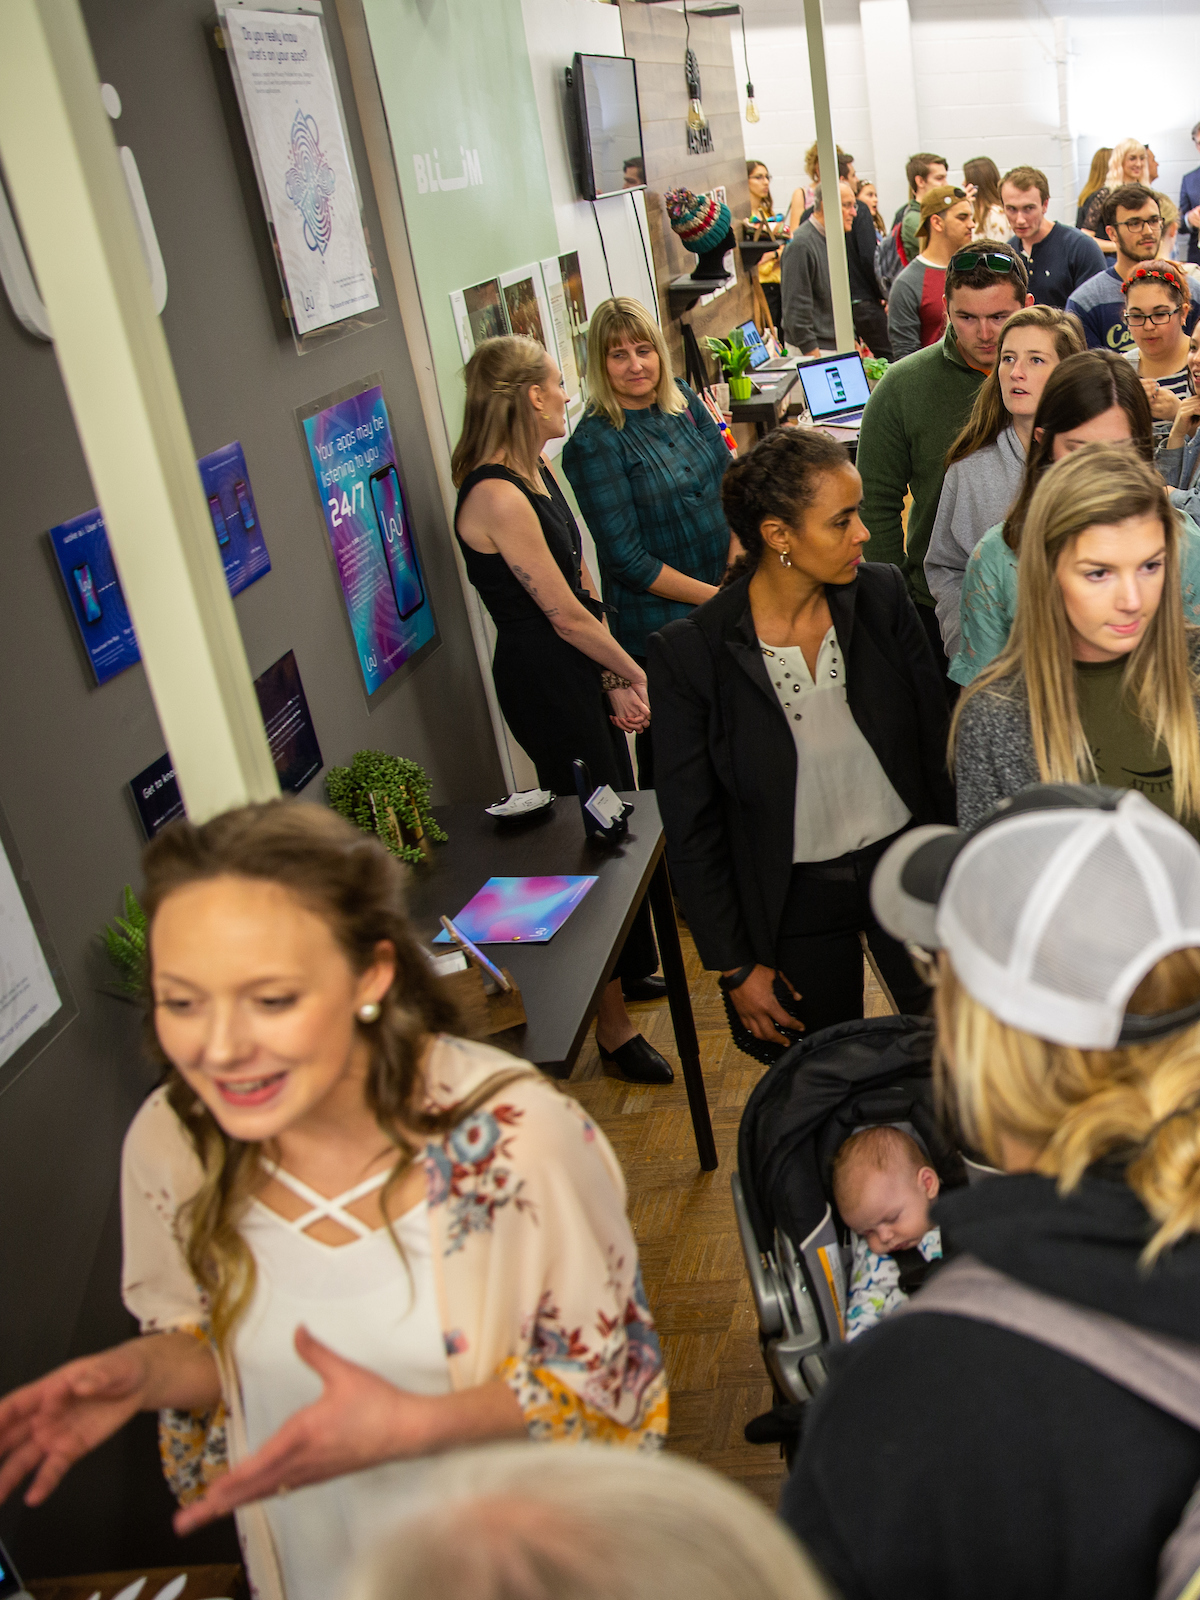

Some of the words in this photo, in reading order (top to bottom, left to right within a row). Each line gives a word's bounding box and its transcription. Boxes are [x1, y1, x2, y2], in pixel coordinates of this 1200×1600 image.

[315, 441, 334, 461] Your
[336, 430, 357, 455] apps
[356, 421, 374, 440] may
[372, 415, 385, 432] be
[320, 460, 357, 488] listening
[355, 453, 364, 469] to
[364, 446, 379, 468] you
[328, 481, 365, 528] 24/7
